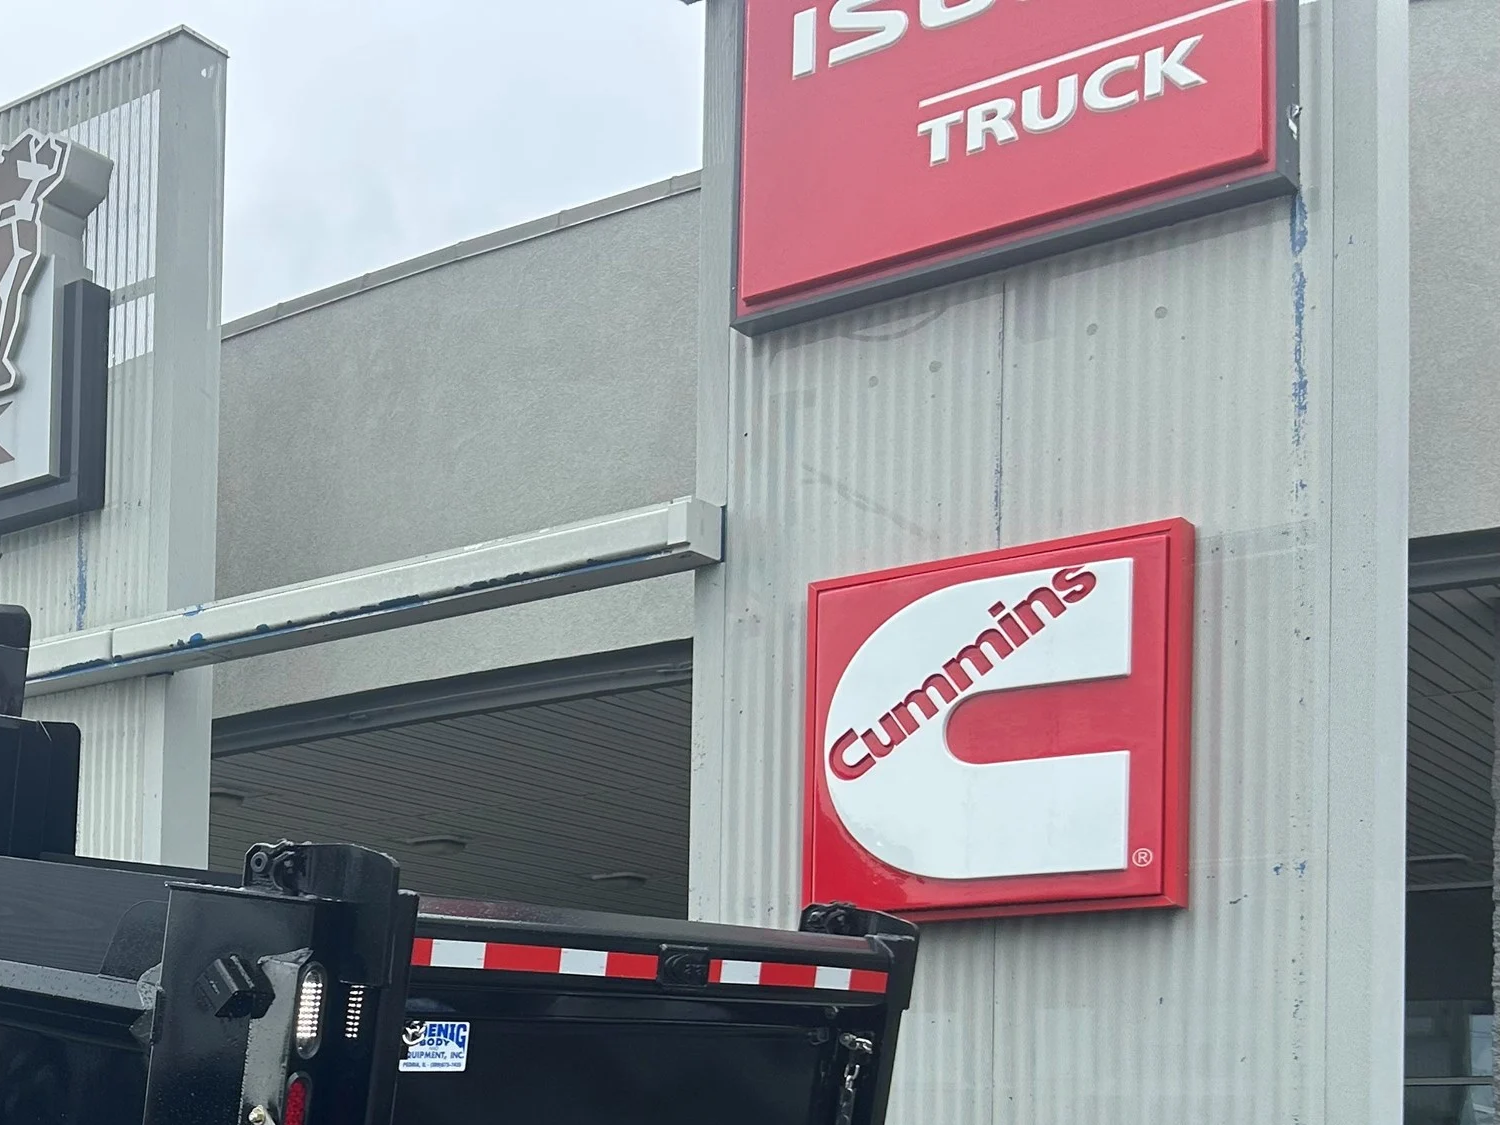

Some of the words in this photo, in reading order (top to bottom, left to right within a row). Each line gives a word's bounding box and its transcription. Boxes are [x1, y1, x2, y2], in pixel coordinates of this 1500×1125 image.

[917, 34, 1207, 167] TRUCK
[828, 566, 1097, 782] Cummins
[420, 1038, 450, 1046] BODY
